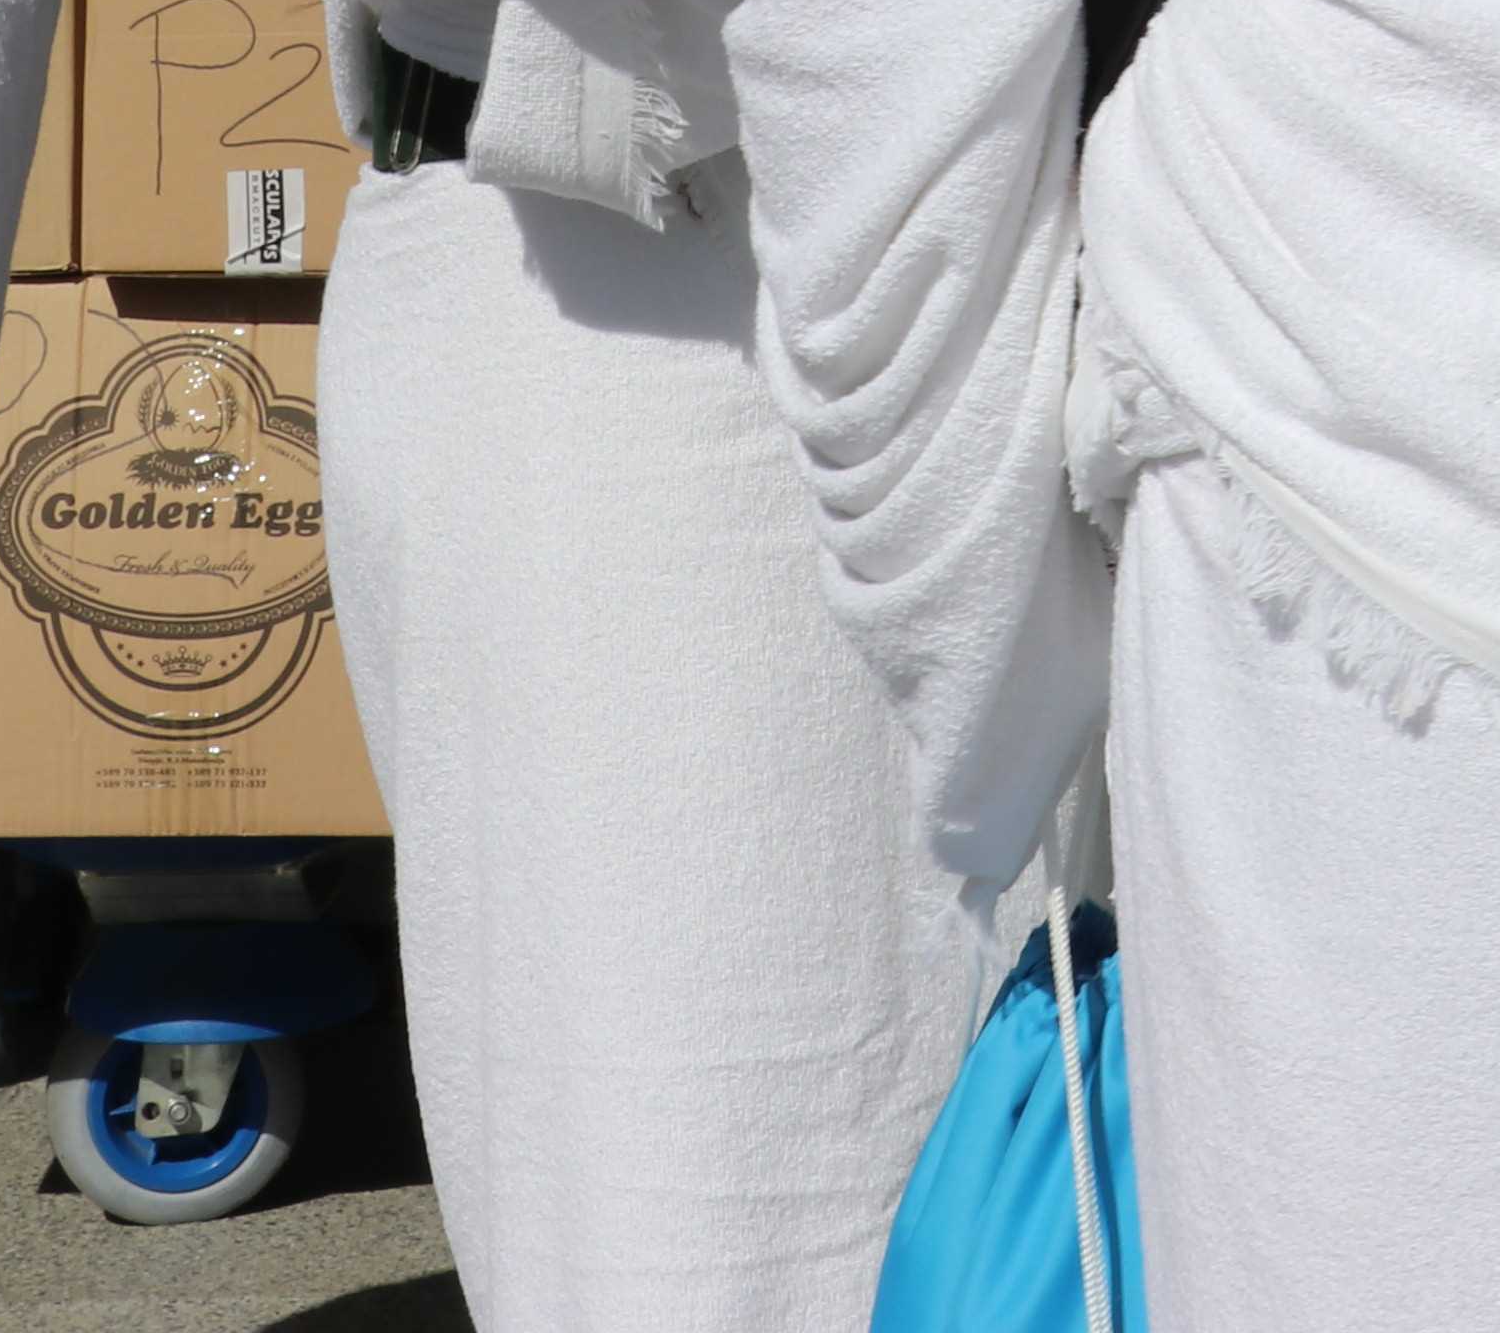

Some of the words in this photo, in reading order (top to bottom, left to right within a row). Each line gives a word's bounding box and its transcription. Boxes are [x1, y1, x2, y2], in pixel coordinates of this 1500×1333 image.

[41, 492, 215, 530] Golden
[230, 492, 324, 538] Egg
[113, 548, 164, 574] Fresh
[168, 559, 190, 576] &
[190, 548, 257, 582] Quality
